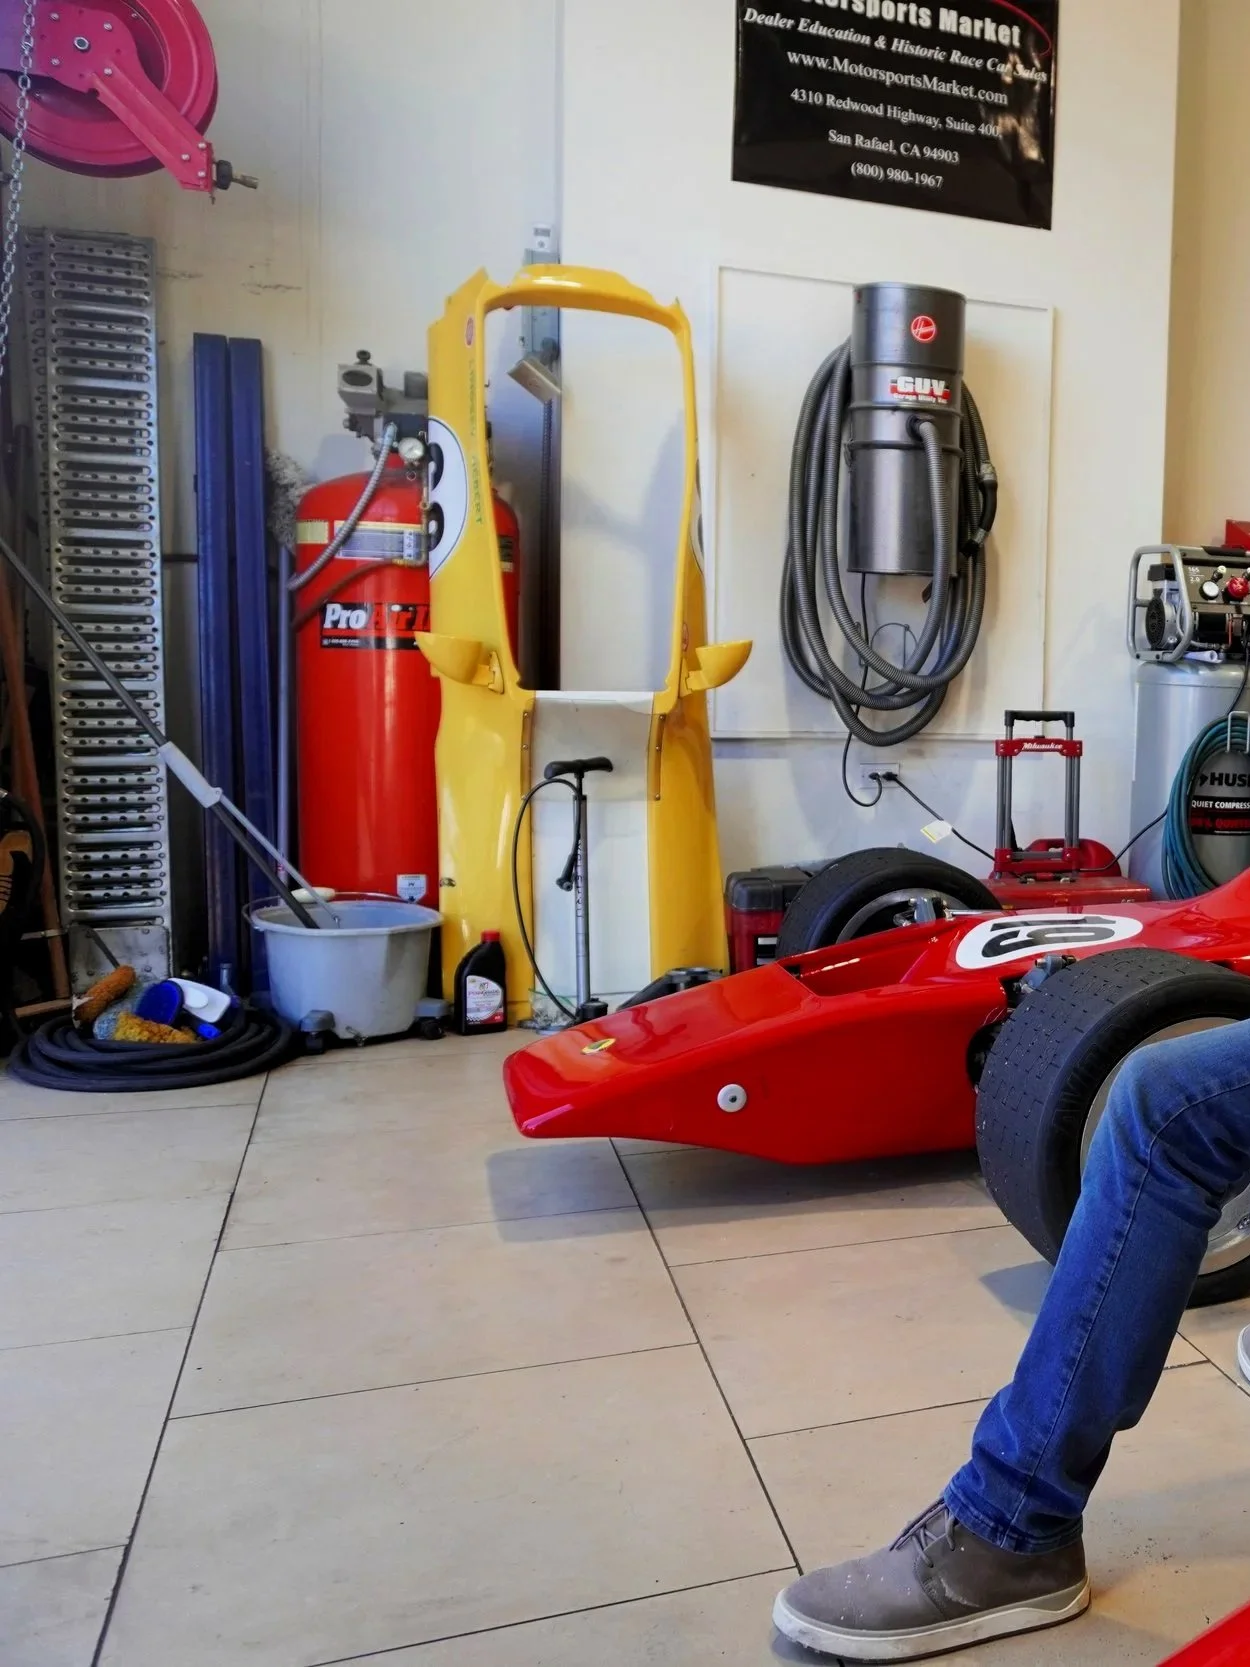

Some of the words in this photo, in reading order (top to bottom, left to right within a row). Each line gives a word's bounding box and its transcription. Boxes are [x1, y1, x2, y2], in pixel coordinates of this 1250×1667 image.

[743, 7, 795, 29] Dealer
[797, 17, 871, 46] Education
[874, 34, 887, 49] &
[890, 37, 947, 60] Historic
[949, 49, 985, 68] Race
[938, 7, 1021, 48] Market
[786, 51, 1009, 105] www.MotorsportsMarket.com
[790, 88, 823, 105] 4310
[825, 93, 884, 116] Redwood
[886, 104, 942, 129] Highway,
[945, 116, 975, 133] Suite
[828, 129, 852, 145] San
[854, 133, 897, 155] Rafael,
[900, 142, 921, 157] CA
[922, 145, 960, 164] 94903
[851, 161, 884, 181] (800)
[886, 167, 943, 188] 980-1967
[897, 376, 946, 397] GUV
[1191, 799, 1214, 809] QUIET
[981, 916, 1117, 958] 19
